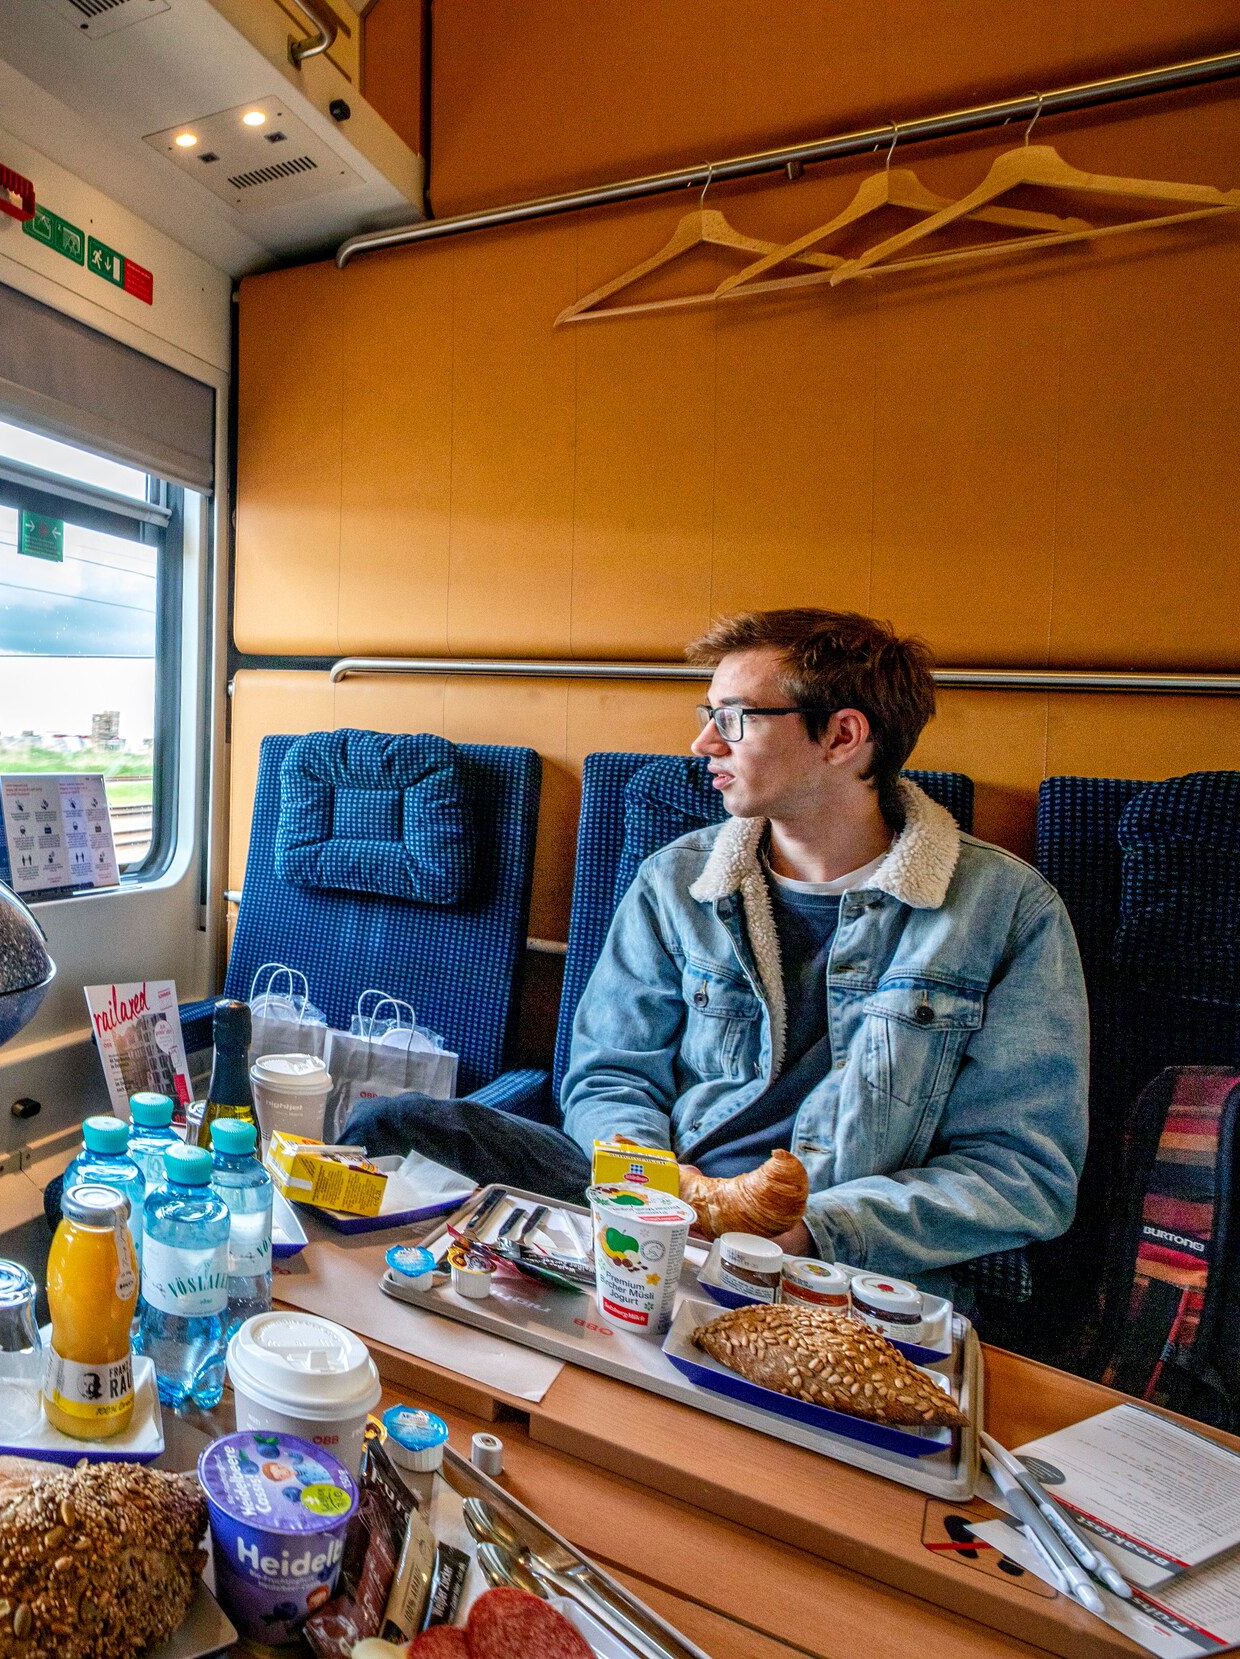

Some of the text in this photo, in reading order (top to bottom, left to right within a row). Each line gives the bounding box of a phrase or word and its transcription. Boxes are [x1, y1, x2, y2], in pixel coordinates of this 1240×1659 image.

[93, 981, 150, 1038] railaxed
[1143, 1226, 1193, 1249] BURTON
[600, 1274, 655, 1300] Bircher Müsli
[605, 1271, 645, 1291] Premium
[609, 1289, 639, 1306] Jogurt
[110, 1372, 131, 1398] RAU
[1075, 1515, 1170, 1567] Breakfast
[236, 1535, 344, 1578] Heidelb
[1132, 1595, 1191, 1634] Frühs
